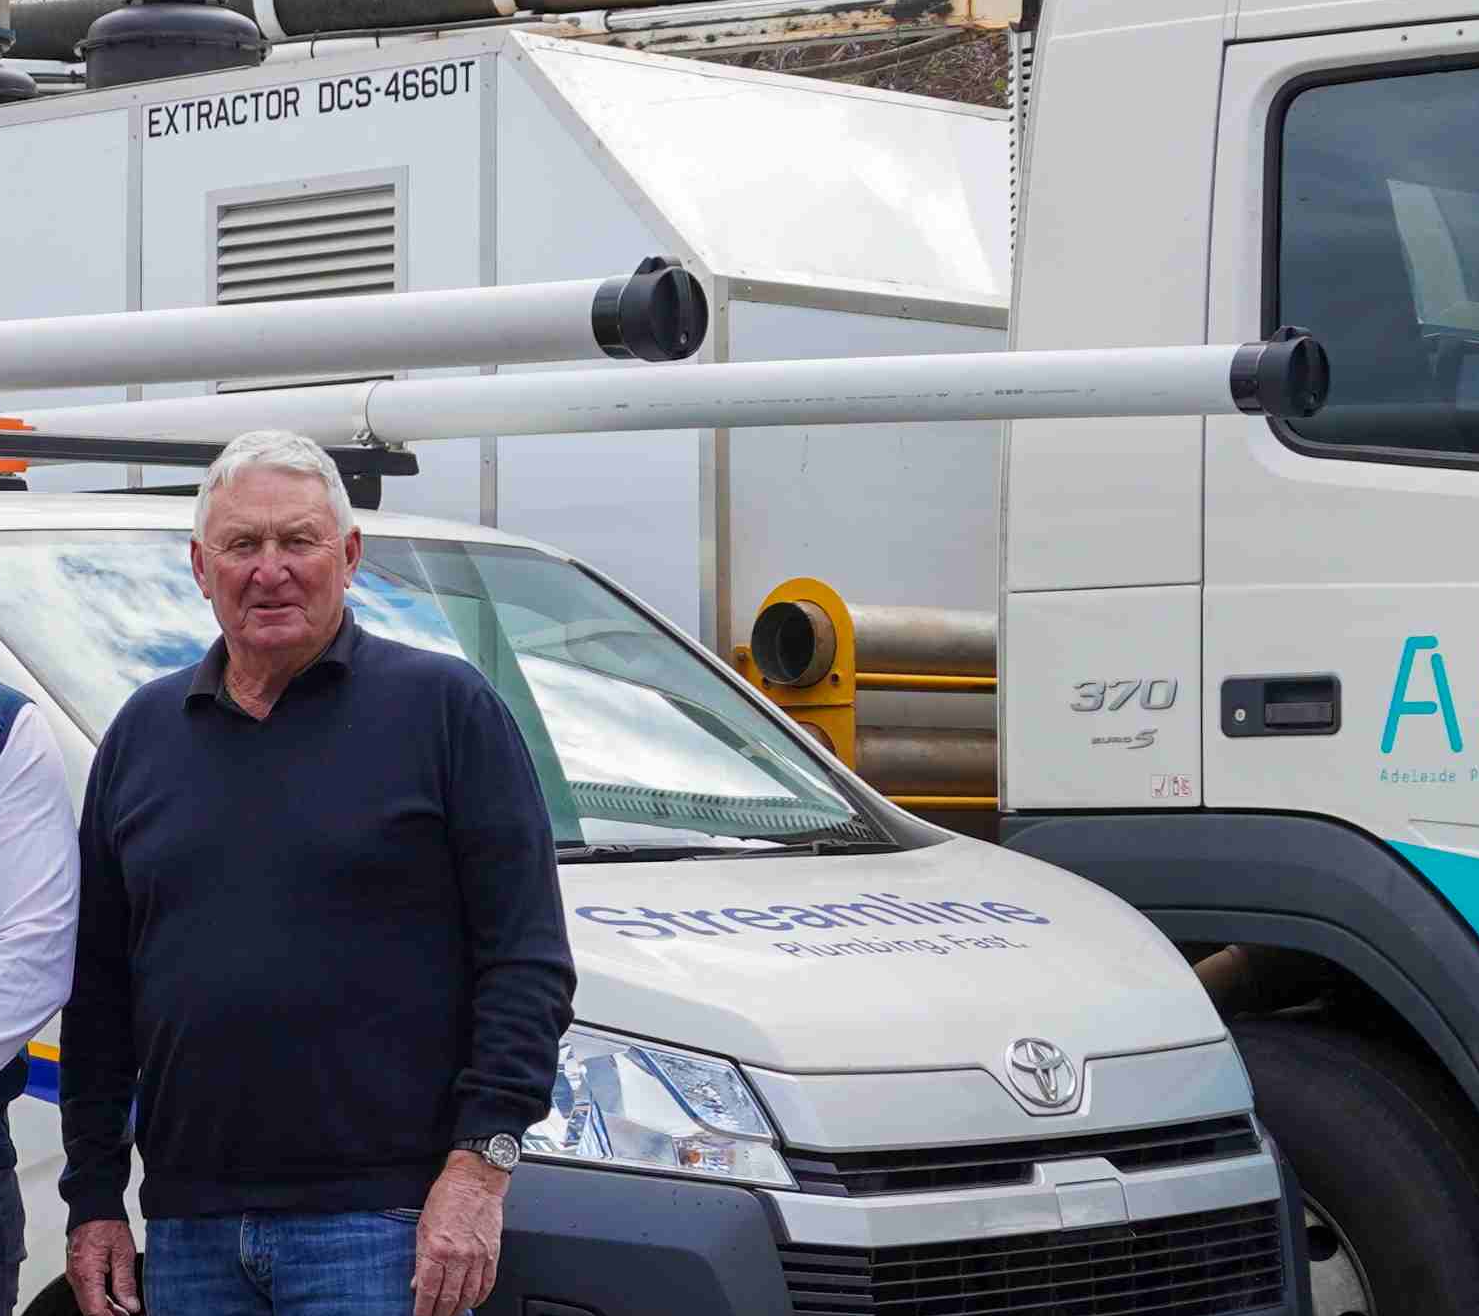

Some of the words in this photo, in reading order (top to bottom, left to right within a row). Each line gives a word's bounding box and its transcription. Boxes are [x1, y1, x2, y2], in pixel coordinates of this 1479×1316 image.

[148, 86, 300, 138] EXTRACTOR
[1070, 678, 1179, 713] 370
[1379, 767, 1458, 784] Adelaide
[574, 892, 1051, 942] Streamline
